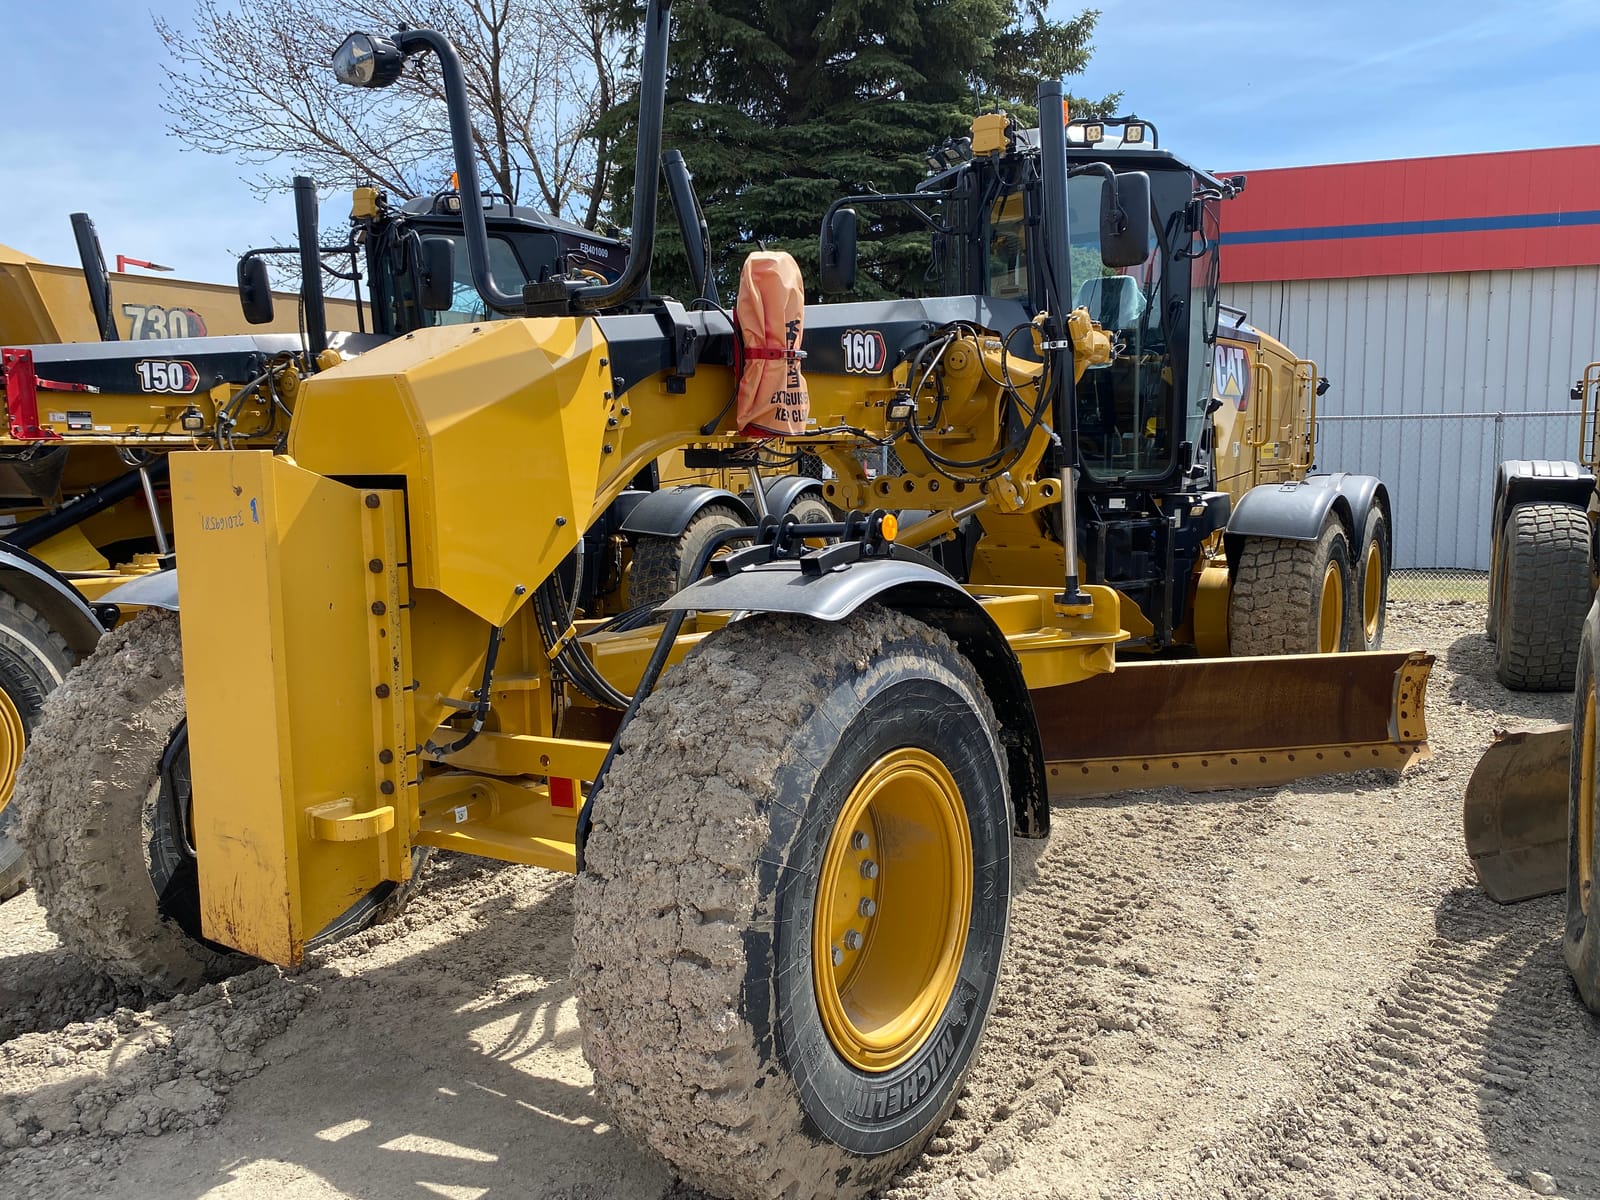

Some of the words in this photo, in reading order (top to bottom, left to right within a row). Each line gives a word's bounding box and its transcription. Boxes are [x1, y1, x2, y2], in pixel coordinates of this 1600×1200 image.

[124, 305, 189, 340] 730
[843, 332, 876, 369] 160
[137, 361, 184, 390] 150
[1214, 345, 1244, 396] CAT
[847, 1029, 955, 1119] MICHELIN
